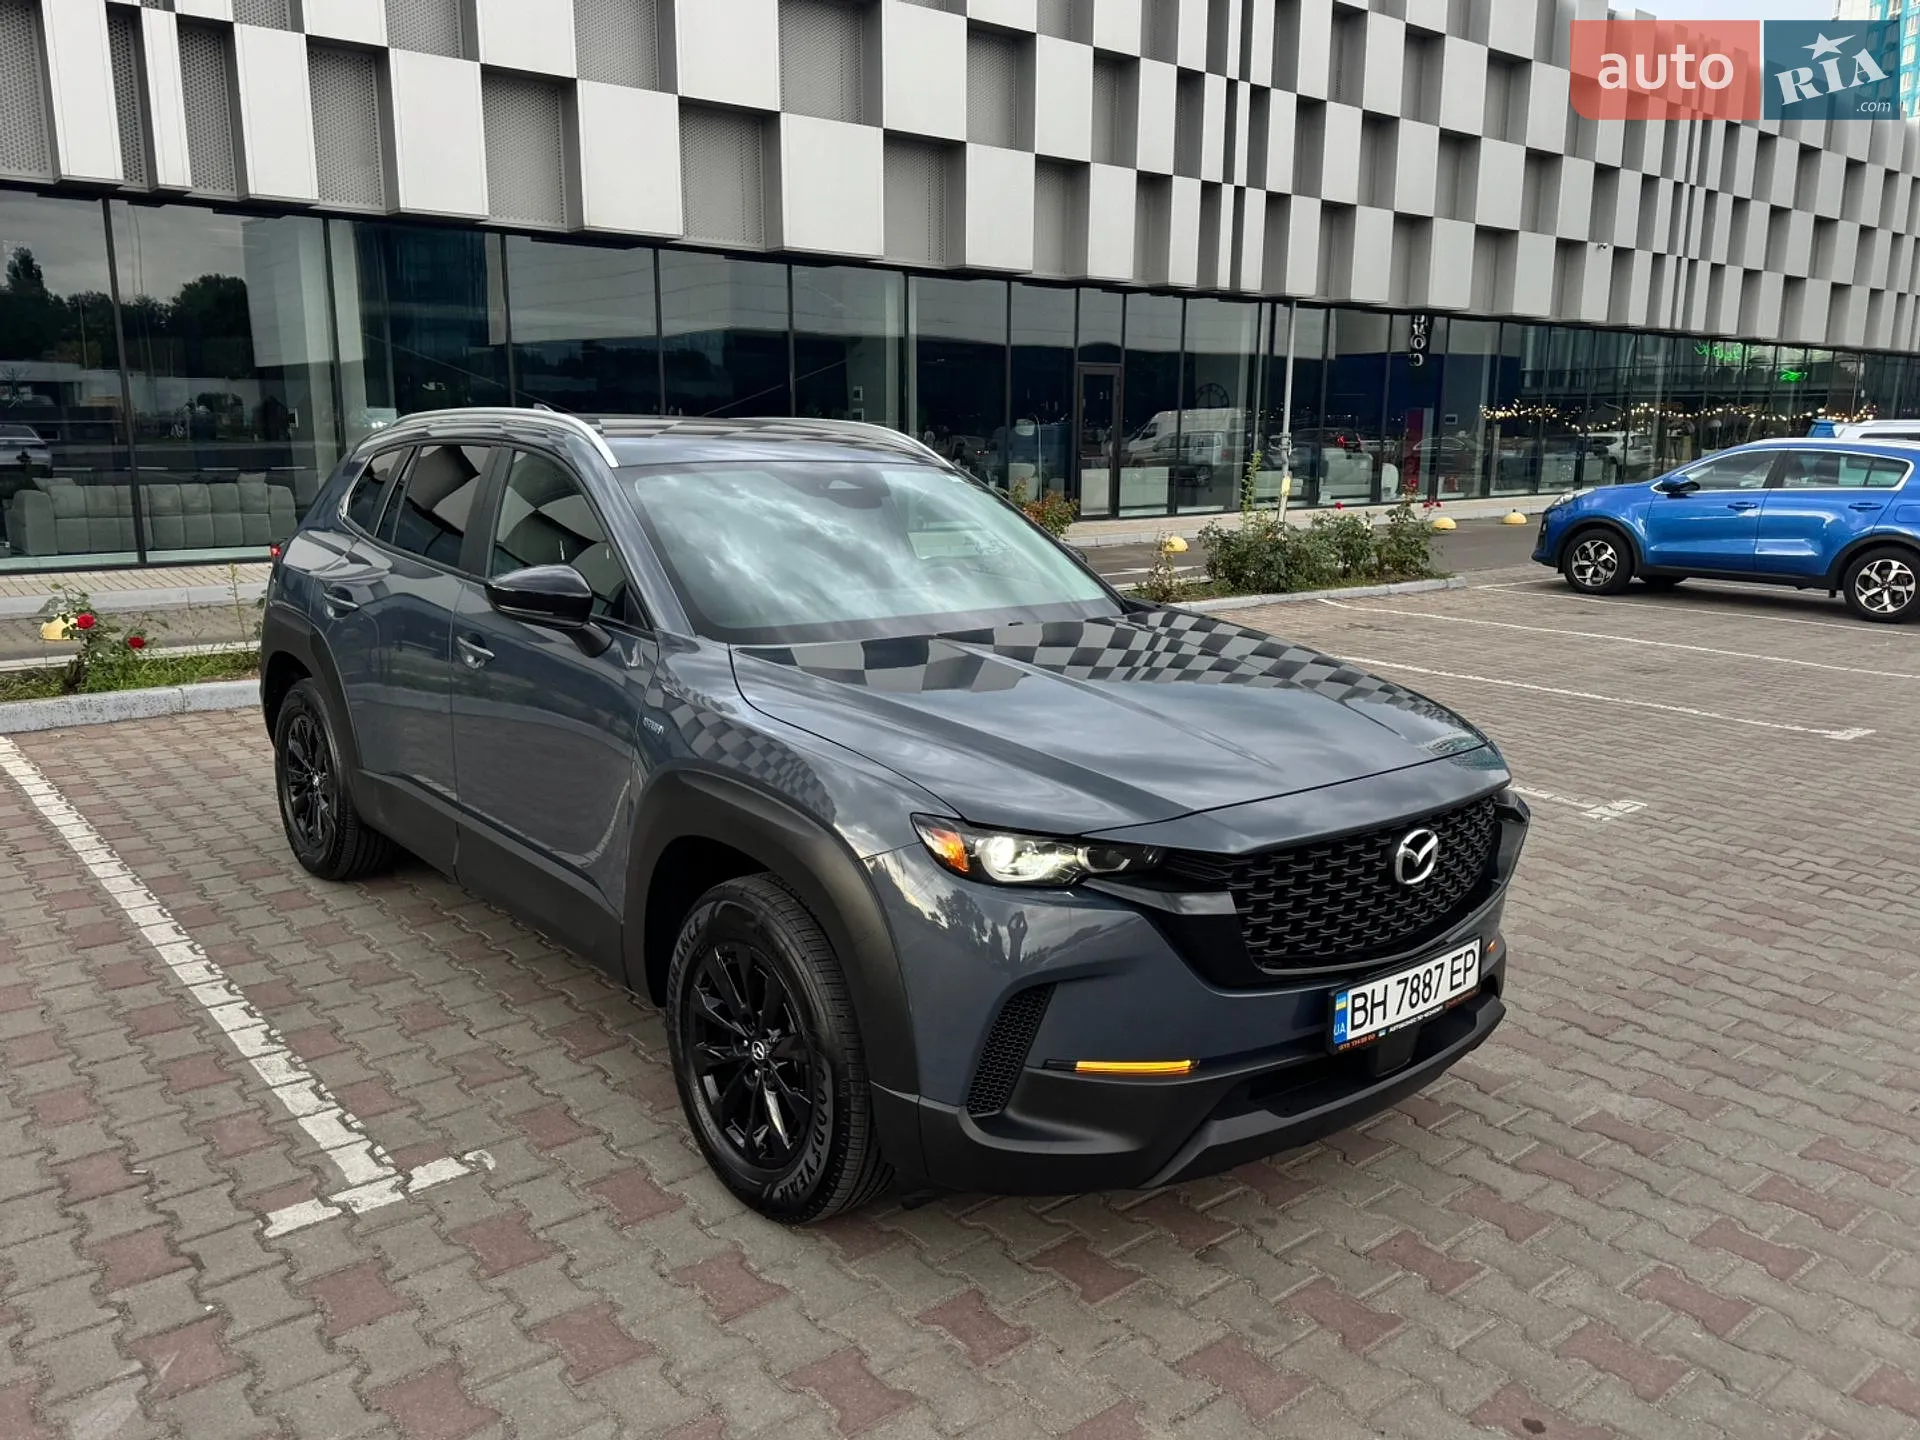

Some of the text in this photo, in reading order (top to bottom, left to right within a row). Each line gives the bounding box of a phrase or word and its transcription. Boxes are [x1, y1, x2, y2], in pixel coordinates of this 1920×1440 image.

[1334, 1021, 1347, 1036] UA
[1350, 984, 1388, 1032] BH
[1396, 962, 1444, 1016] 7887
[1449, 948, 1476, 992] EP
[779, 1064, 828, 1201] GOODYEAR
